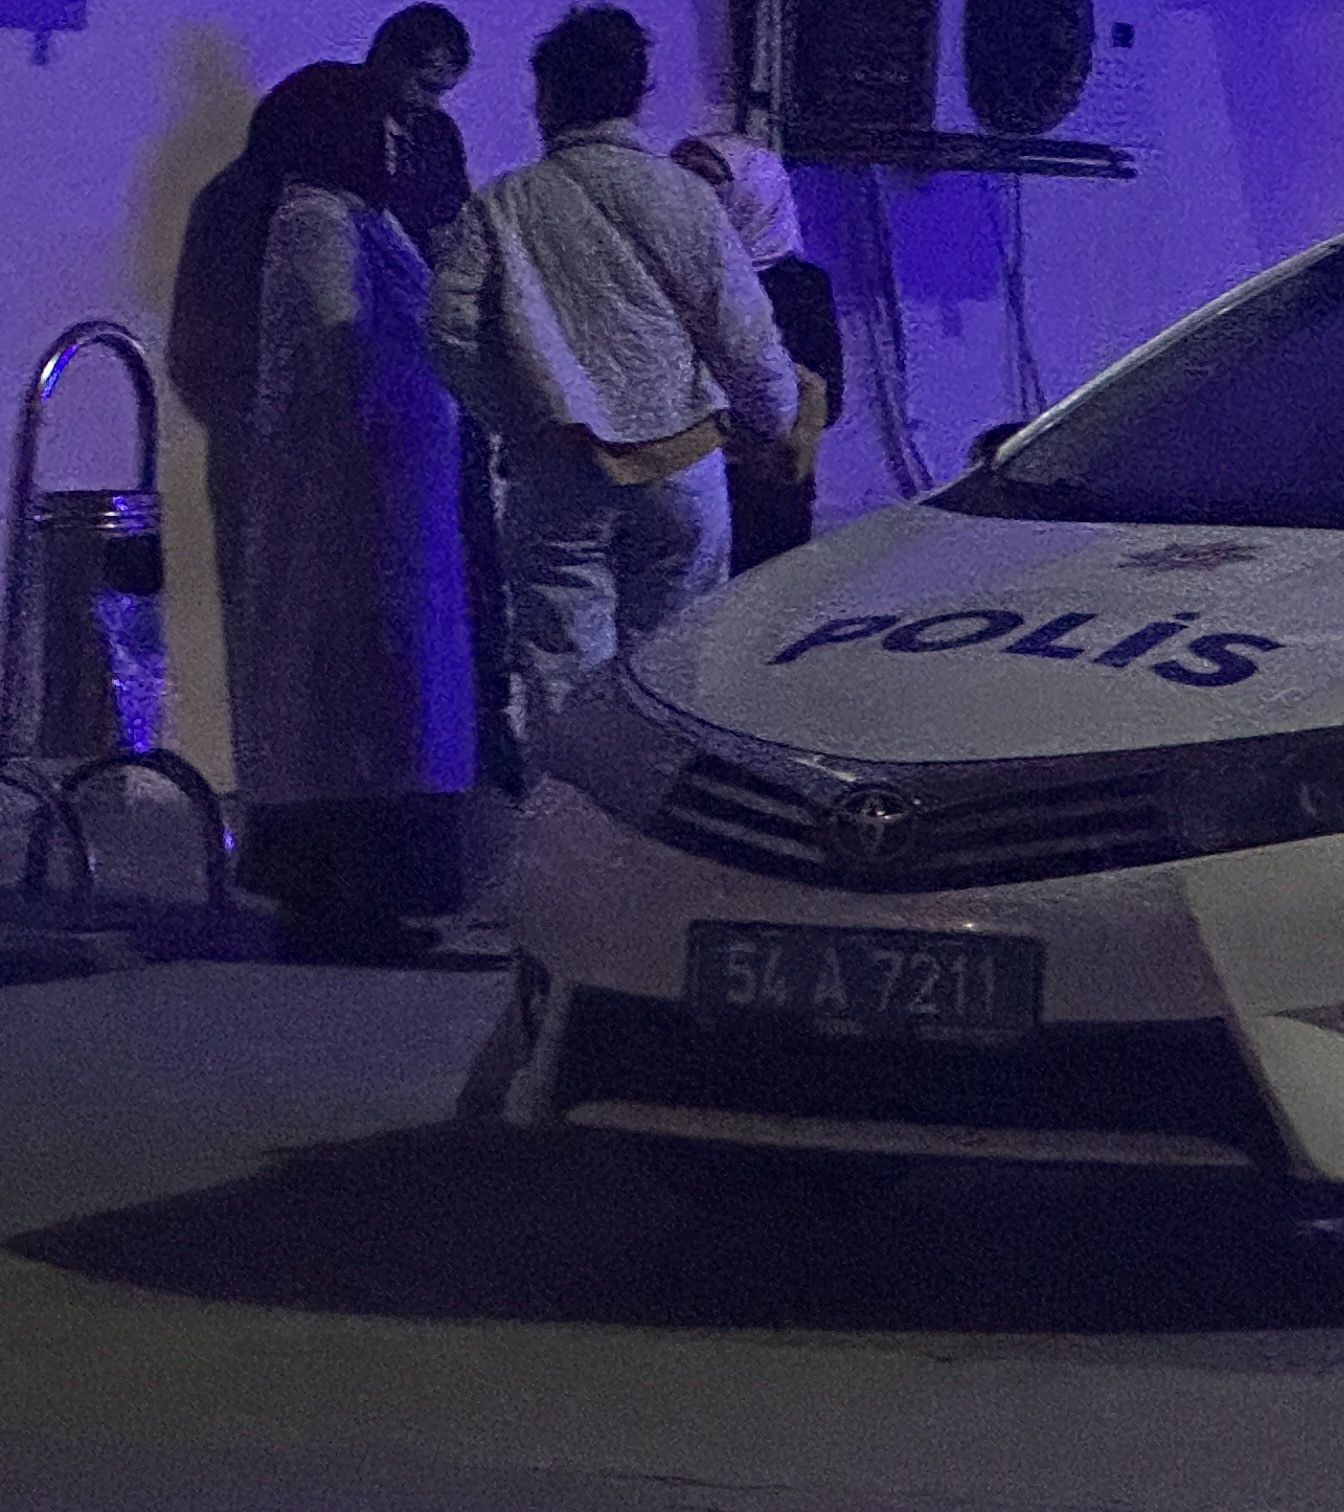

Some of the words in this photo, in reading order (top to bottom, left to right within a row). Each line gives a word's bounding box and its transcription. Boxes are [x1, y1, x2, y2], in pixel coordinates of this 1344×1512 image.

[764, 610, 1285, 687] POLİS
[725, 941, 789, 1006] 54
[870, 948, 998, 1019] 7211
